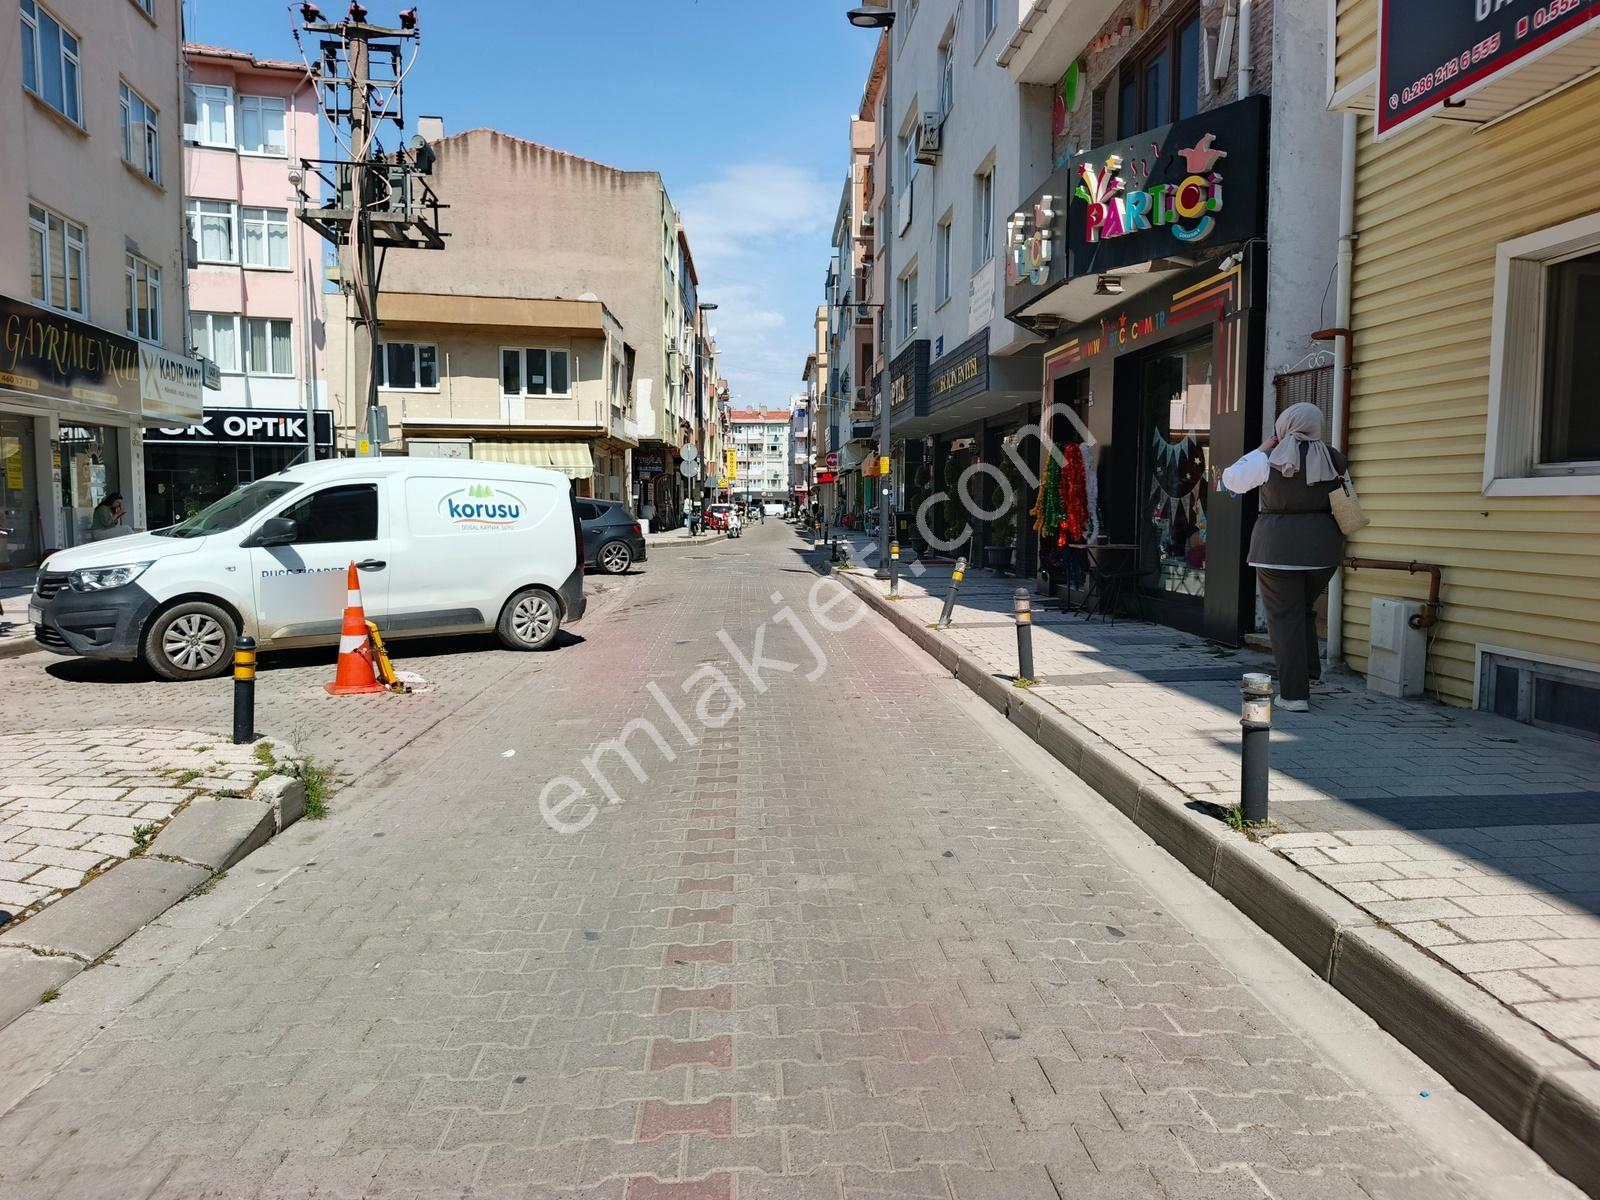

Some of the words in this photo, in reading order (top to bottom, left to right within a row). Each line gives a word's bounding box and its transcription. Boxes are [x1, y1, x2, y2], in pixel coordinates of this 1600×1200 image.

[1402, 74, 1434, 104] 0.286
[1434, 59, 1459, 87] 212
[1460, 51, 1471, 70] 6
[1471, 32, 1500, 63] 555
[5, 314, 138, 388] GAYRİMENKUL
[160, 357, 184, 385] KADİR
[223, 416, 306, 437] OPTİK
[448, 498, 520, 518] korusu
